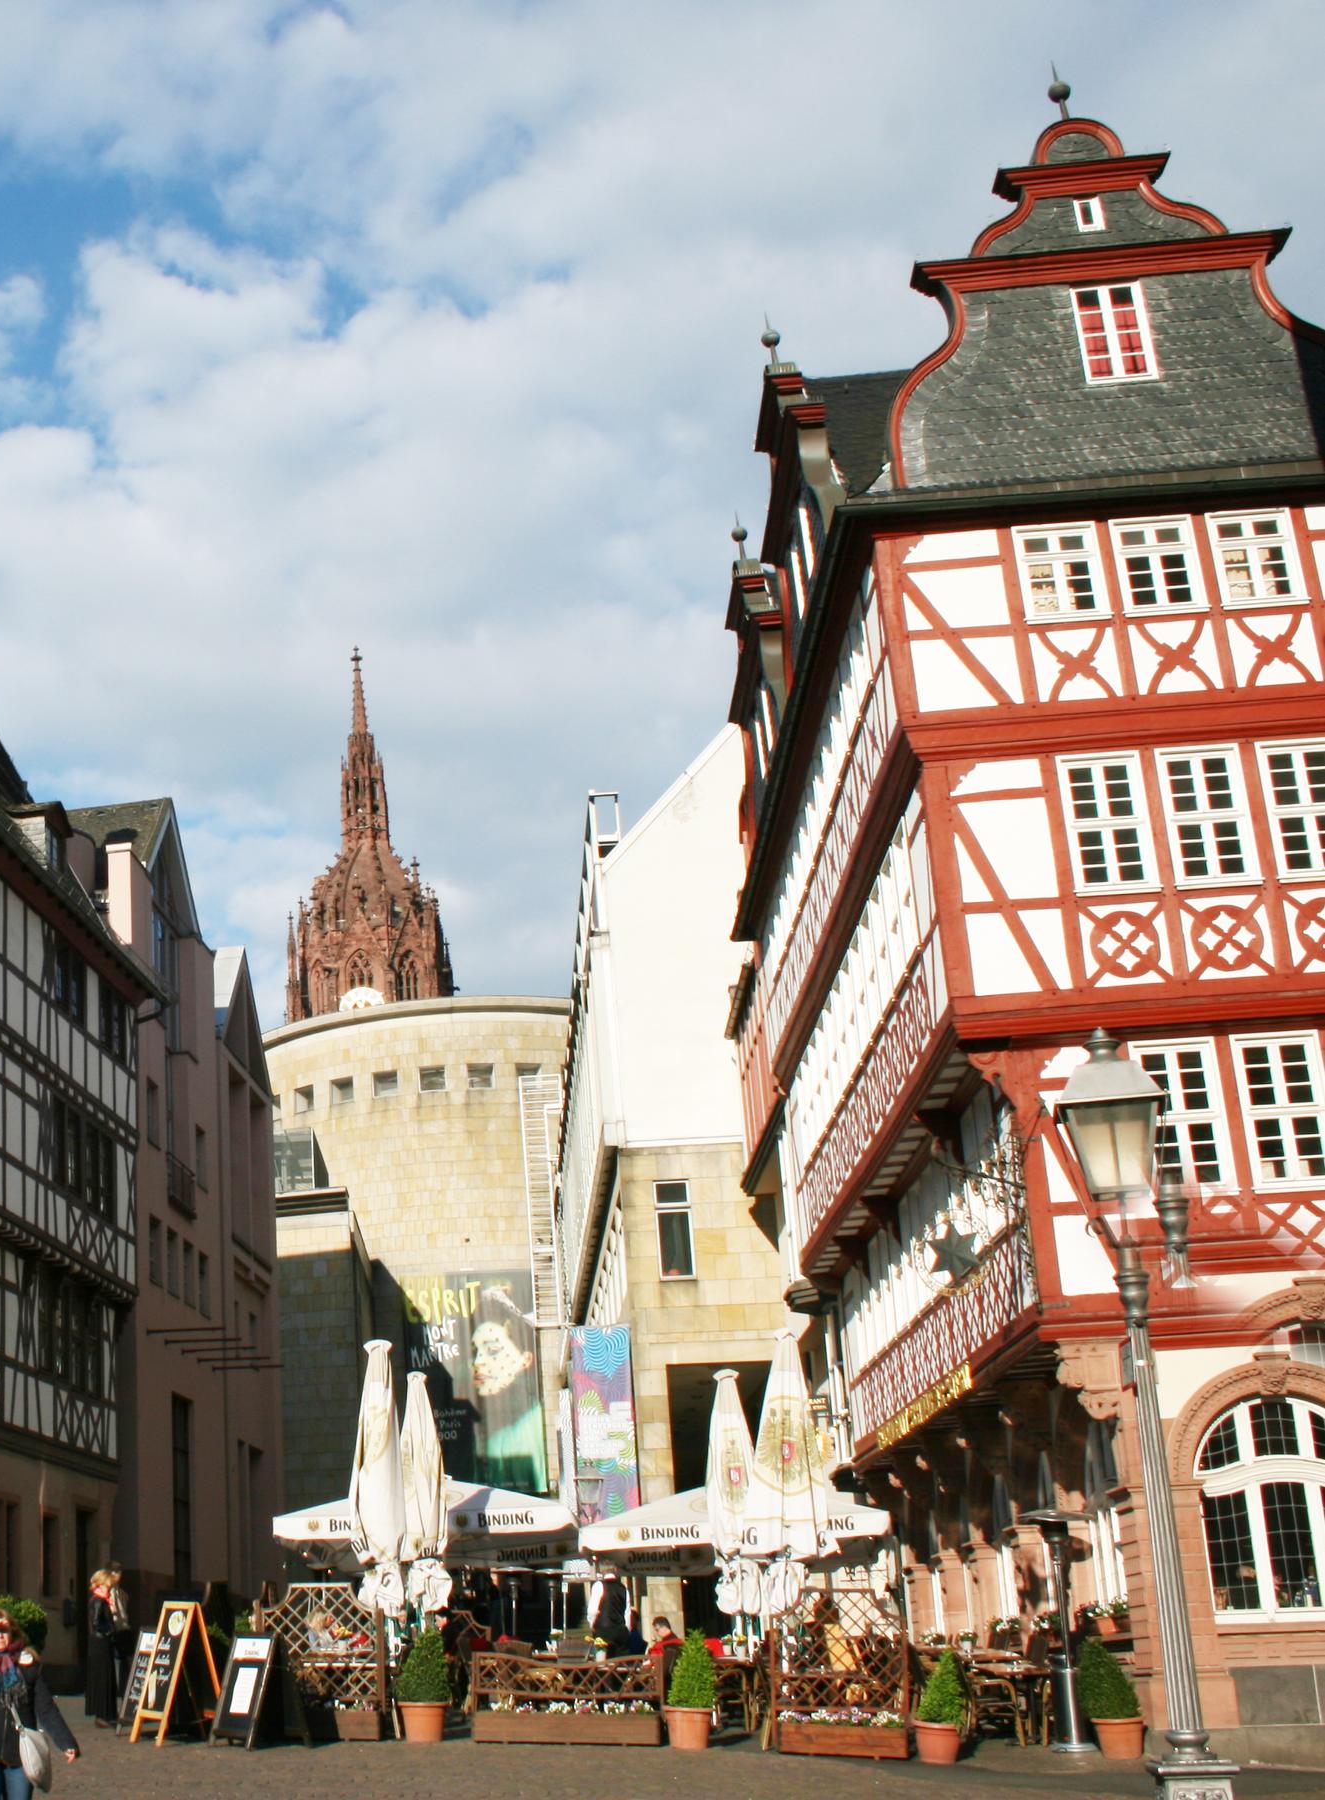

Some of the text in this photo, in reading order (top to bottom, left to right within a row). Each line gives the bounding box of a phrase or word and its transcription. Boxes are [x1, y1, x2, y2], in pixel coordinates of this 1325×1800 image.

[405, 1281, 481, 1325] ESPRIT
[422, 1319, 456, 1346] MONT
[411, 1342, 460, 1369] MARTRE
[439, 1420, 462, 1429] Paris
[437, 1430, 458, 1441] 900
[477, 1511, 534, 1528] BINDING
[640, 1524, 700, 1541] BINDING
